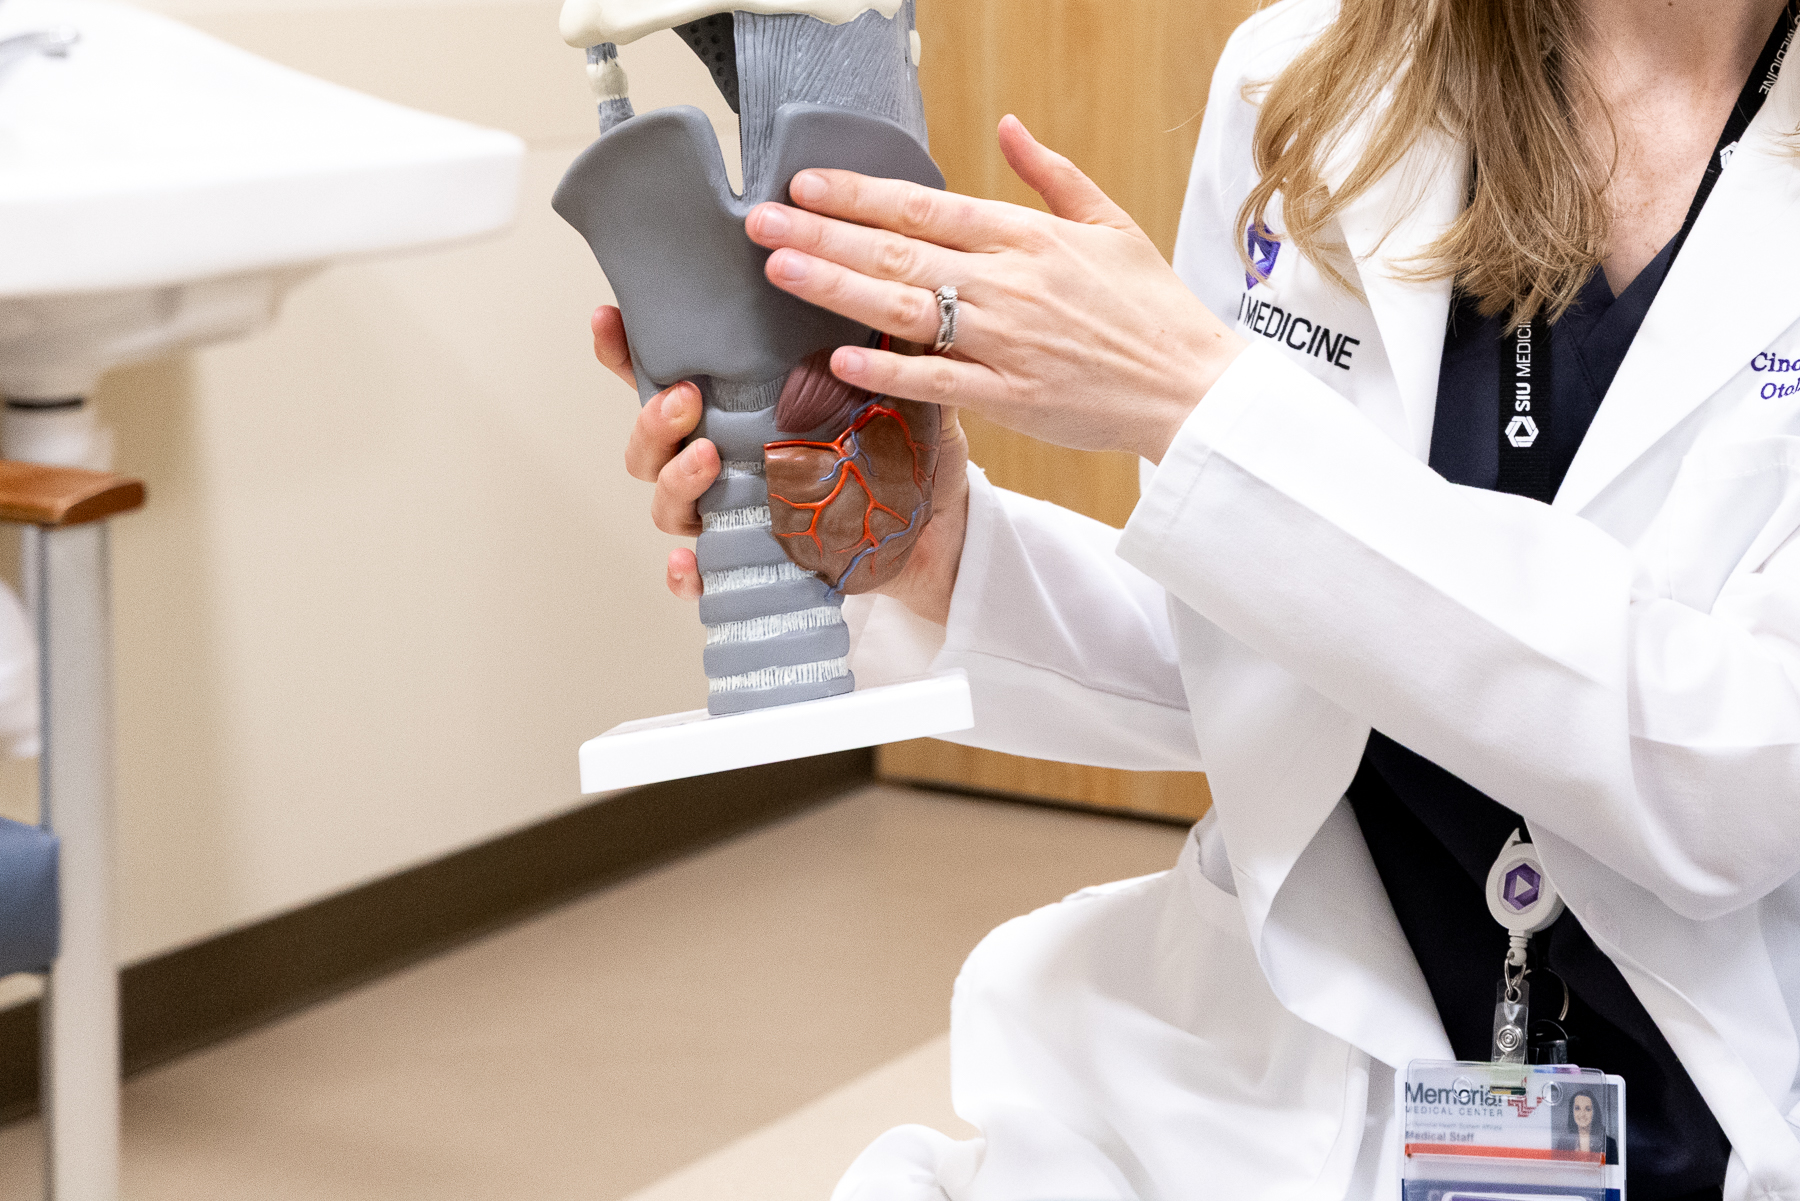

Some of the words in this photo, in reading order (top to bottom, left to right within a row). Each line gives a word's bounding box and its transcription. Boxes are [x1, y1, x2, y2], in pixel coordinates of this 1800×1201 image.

[1243, 296, 1360, 371] MEDICINE
[1515, 382, 1531, 412] SIU
[1406, 1105, 1453, 1115] MEDICAL
[1459, 1108, 1503, 1117] CENTER
[1405, 1130, 1446, 1142] Medical
[1449, 1131, 1475, 1142] Staff
